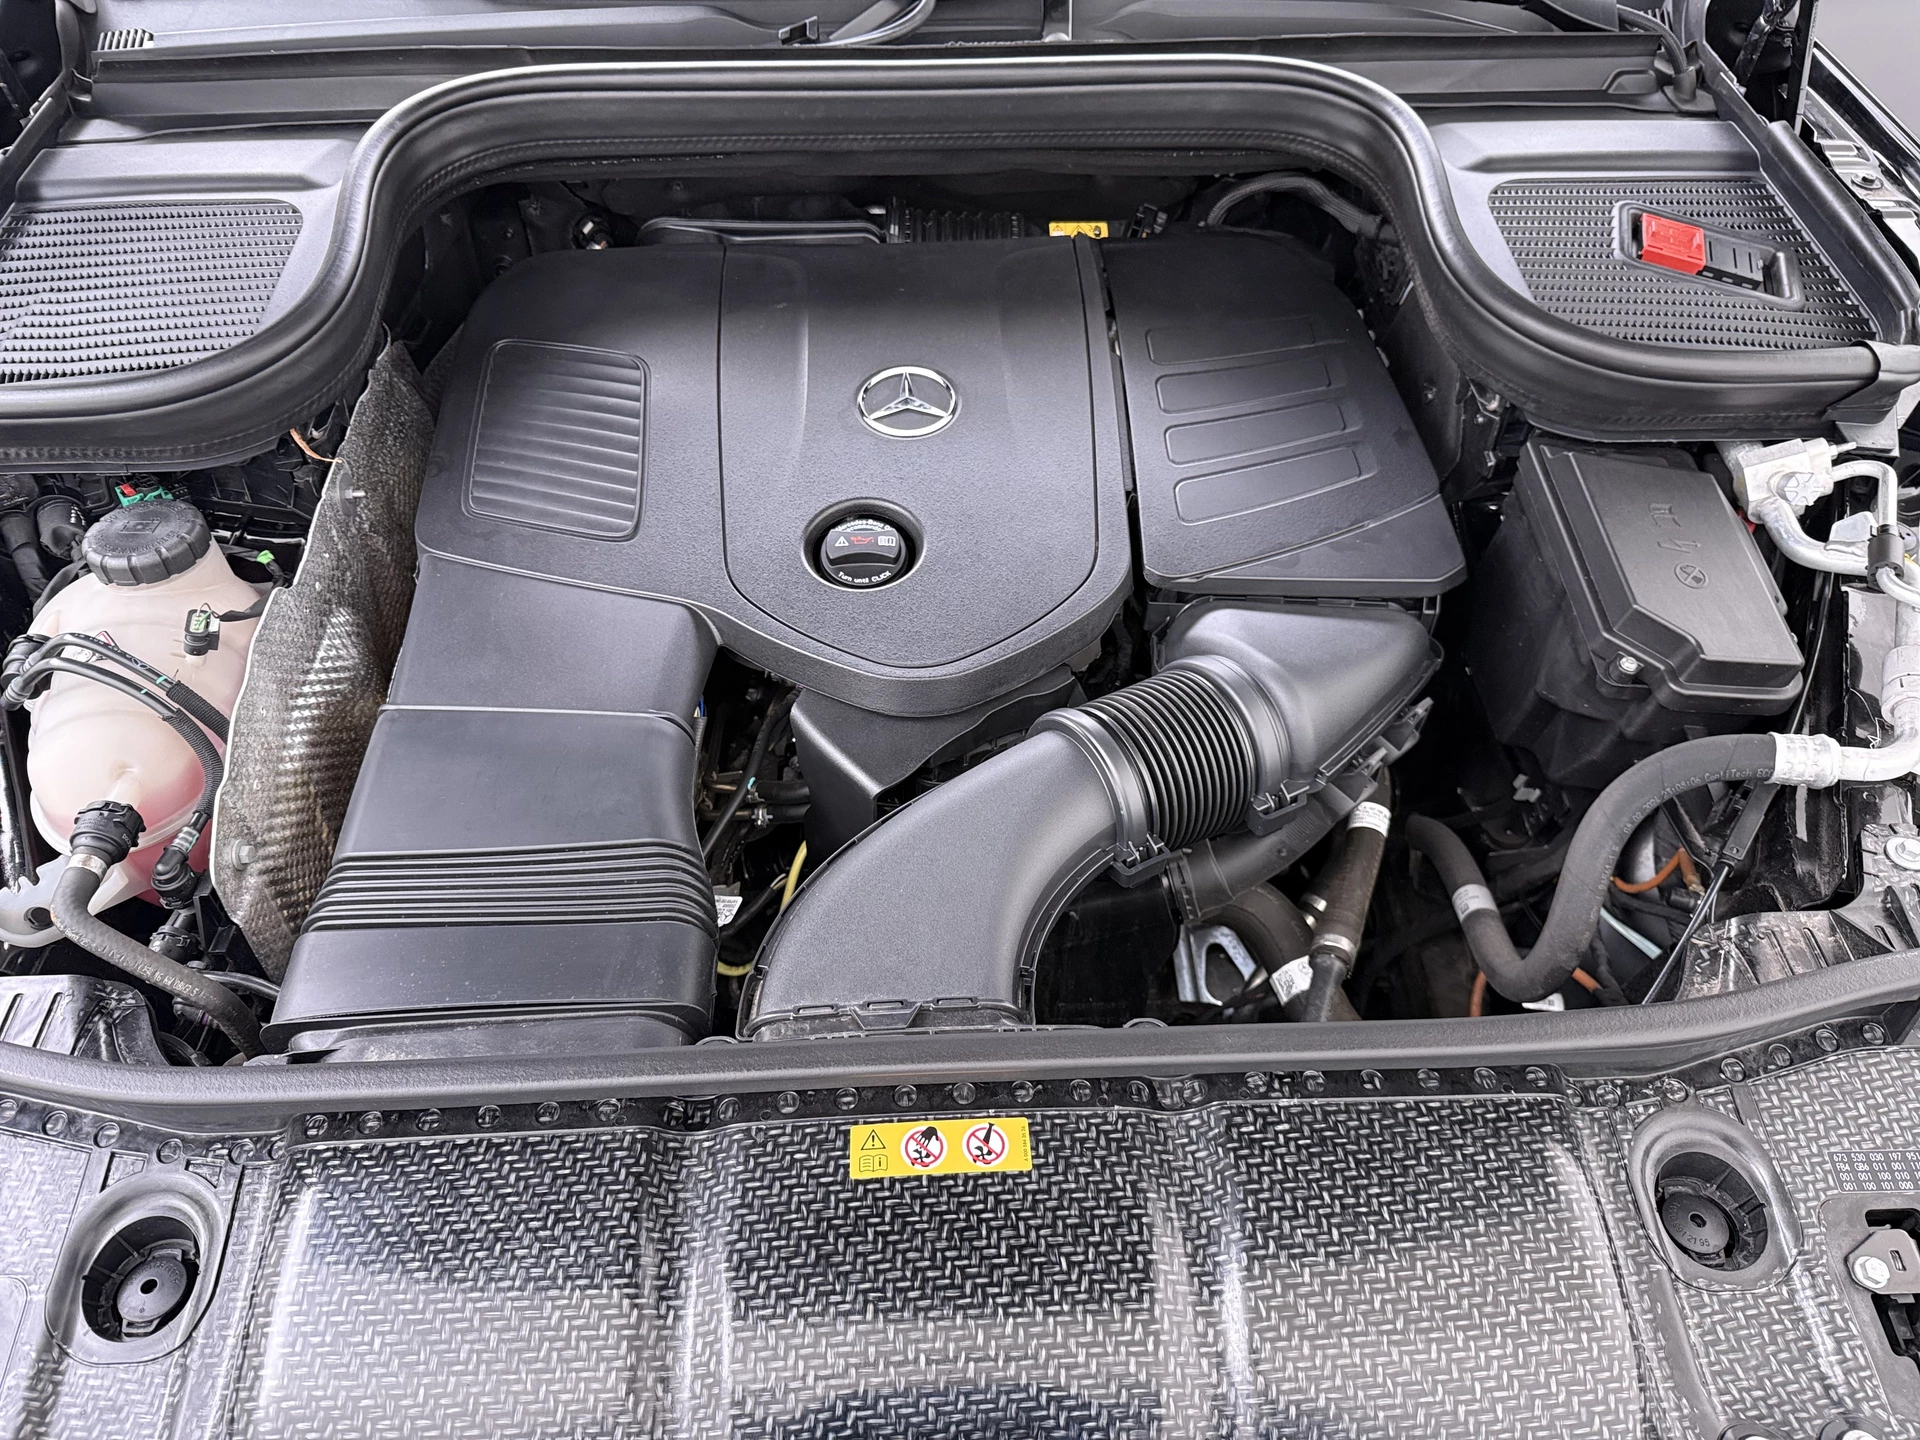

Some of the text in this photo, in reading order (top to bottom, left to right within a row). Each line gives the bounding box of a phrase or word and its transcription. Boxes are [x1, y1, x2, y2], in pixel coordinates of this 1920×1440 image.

[838, 571, 853, 582] Turn
[871, 570, 892, 582] CLICK
[1704, 768, 1753, 782] ContiTech
[1833, 1154, 1848, 1162] 673
[1851, 1153, 1866, 1162] 530
[1869, 1153, 1885, 1161] 030
[1888, 1152, 1901, 1161] 197
[1835, 1163, 1851, 1172] FB4
[1872, 1162, 1888, 1171] 011
[1891, 1162, 1906, 1171] 001
[1840, 1172, 1855, 1181] 001
[1857, 1172, 1873, 1180] 001
[1877, 1172, 1892, 1180] 100
[1894, 1171, 1910, 1180] 010
[1843, 1182, 1858, 1191] 001
[1862, 1182, 1877, 1190] 100
[1881, 1181, 1895, 1190] 101
[1898, 1181, 1914, 1190] 000
